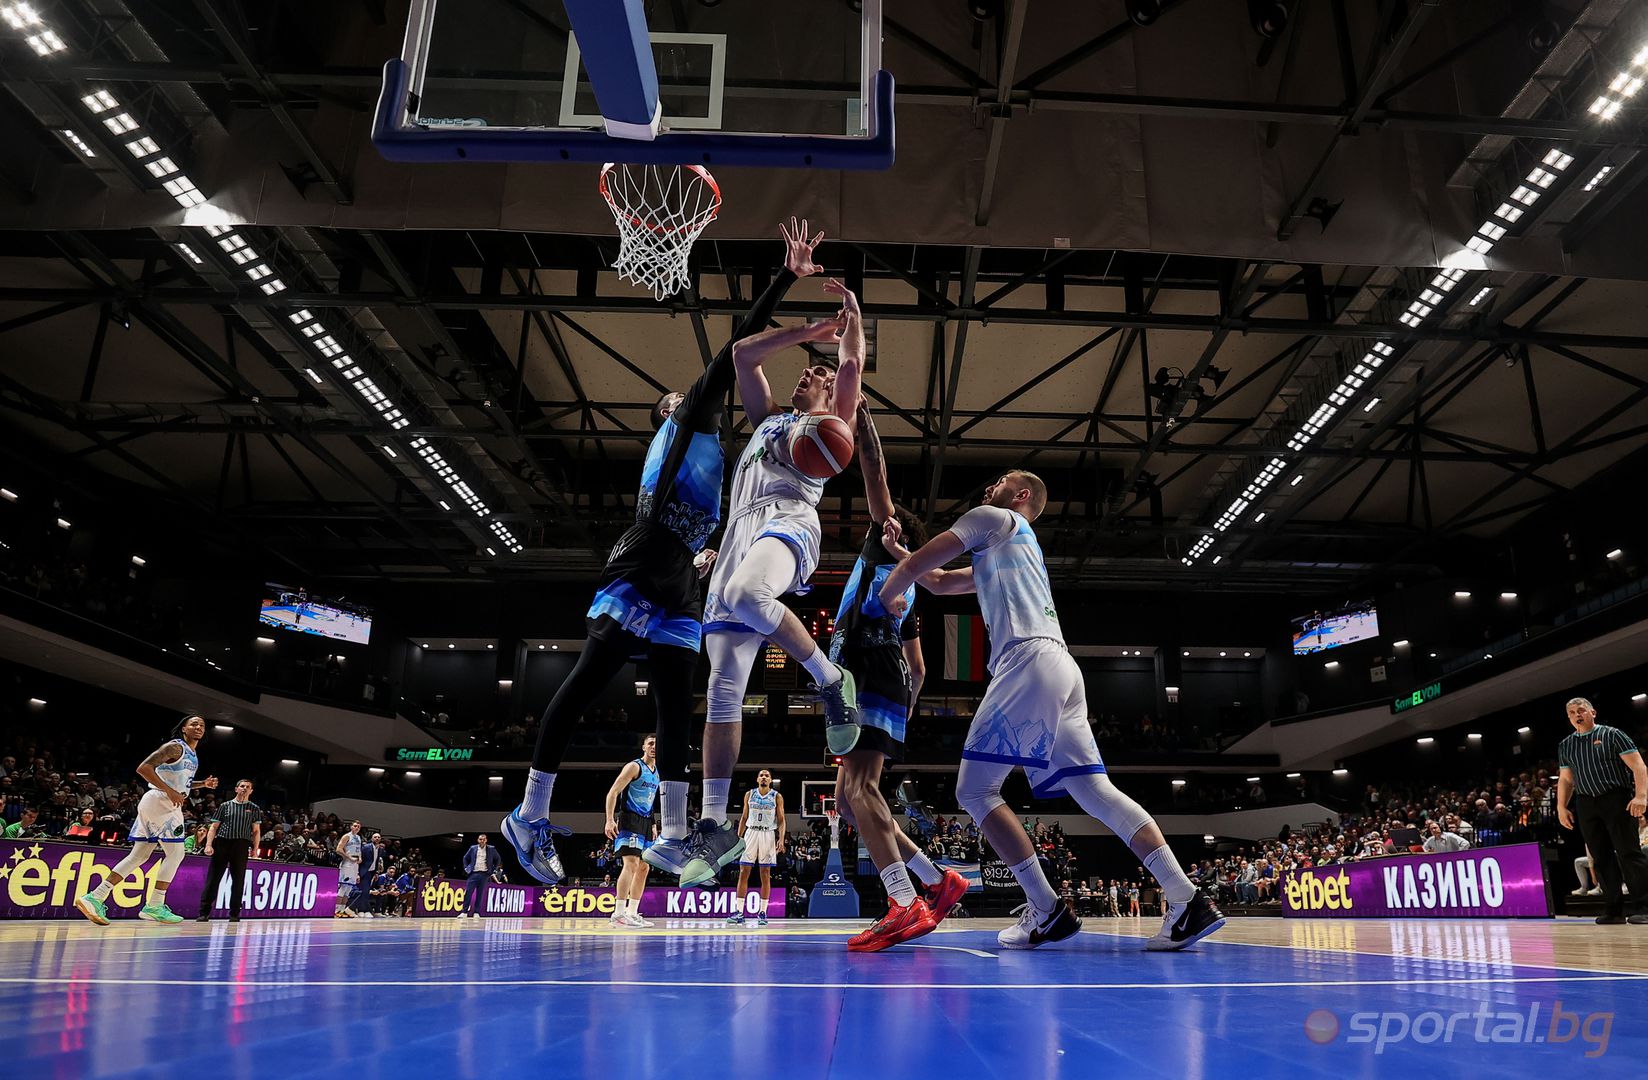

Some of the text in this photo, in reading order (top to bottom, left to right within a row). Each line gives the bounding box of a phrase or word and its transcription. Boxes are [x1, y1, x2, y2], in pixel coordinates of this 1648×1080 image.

[621, 606, 650, 638] 14
[1395, 682, 1441, 712] SamELYON
[397, 748, 474, 760] SamELYON
[424, 881, 525, 913] efbe КАЗИНО
[1288, 857, 1504, 910] efbet КАЗИНО
[544, 889, 616, 913] efbe
